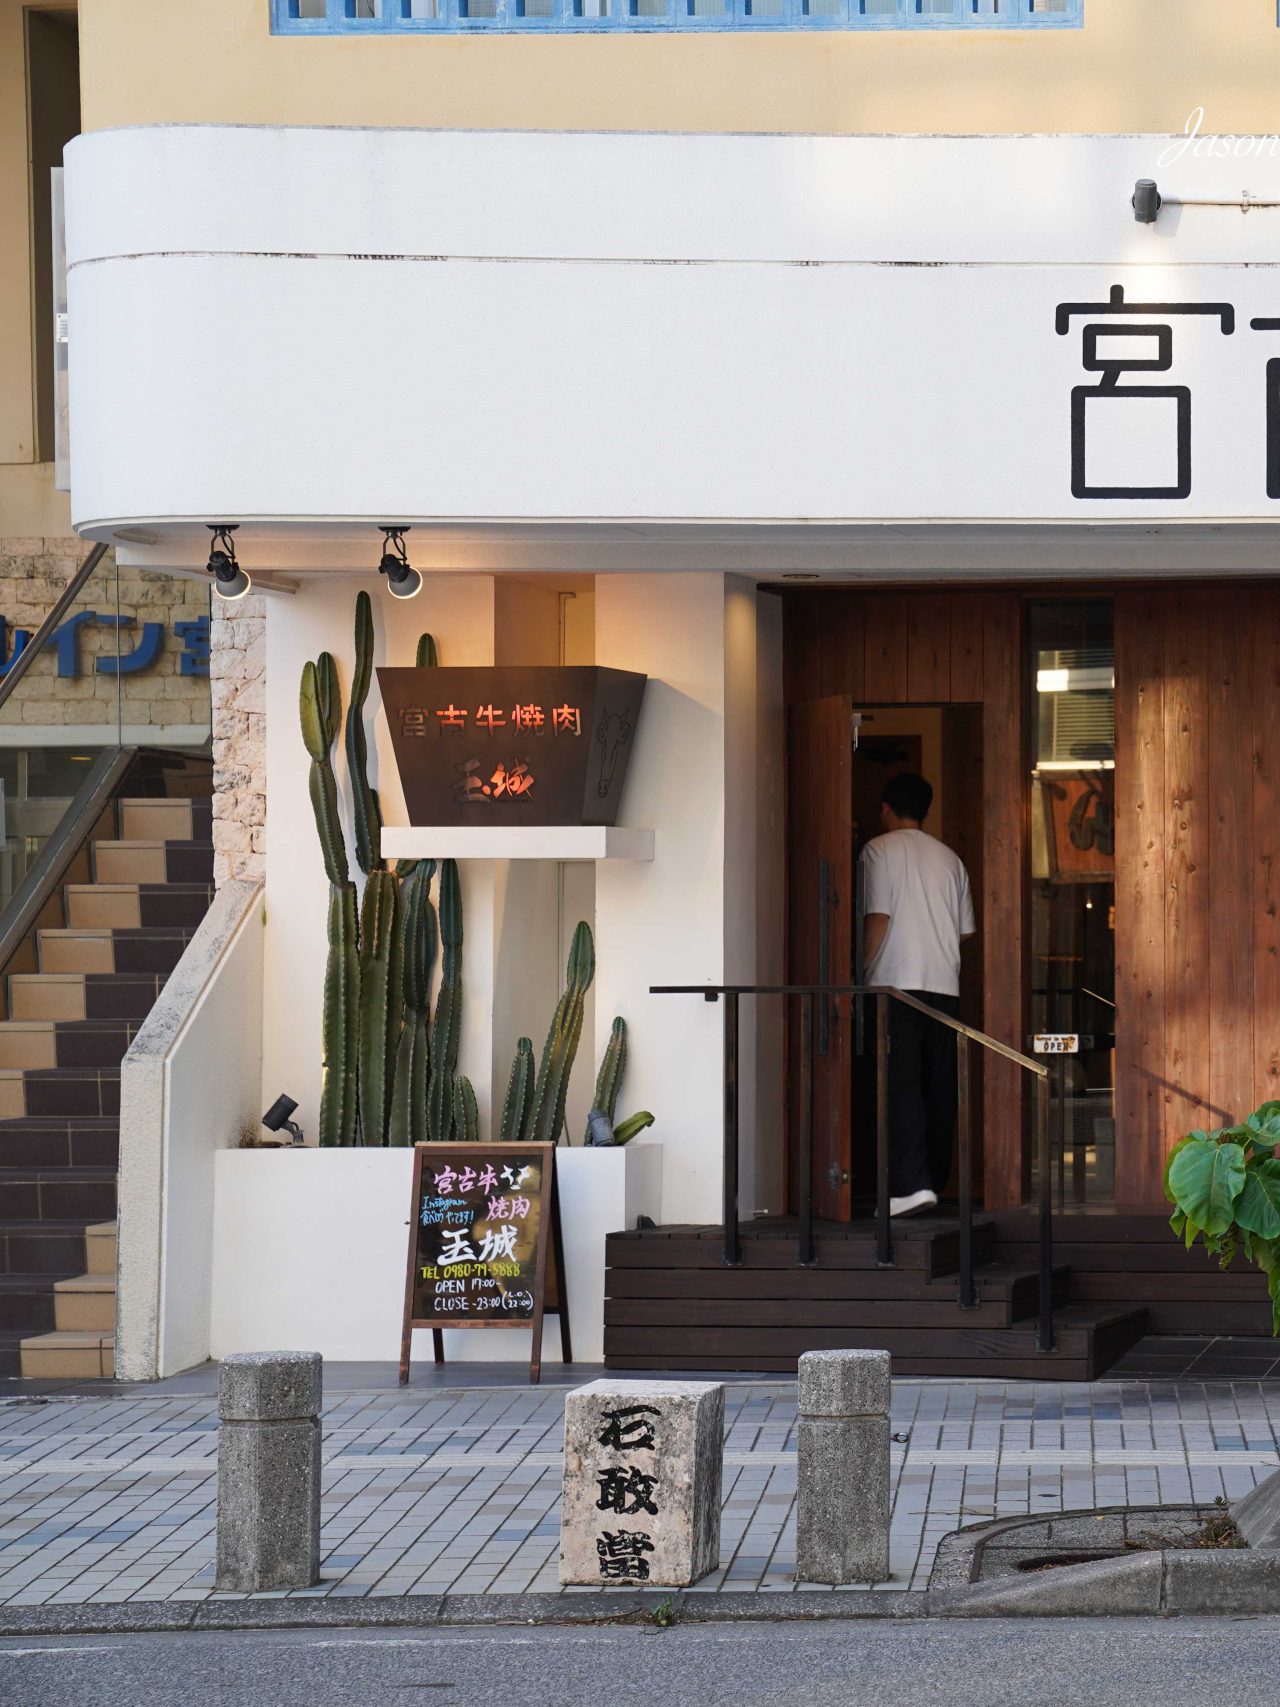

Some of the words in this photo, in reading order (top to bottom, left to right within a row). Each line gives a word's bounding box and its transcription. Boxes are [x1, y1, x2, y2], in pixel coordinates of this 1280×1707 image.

[433, 1163, 499, 1195] 宮古牛
[486, 1195, 531, 1221] 焼肉
[421, 1266, 440, 1280] TEL
[435, 1279, 466, 1294] OPEN
[434, 1297, 470, 1311] CLOSE
